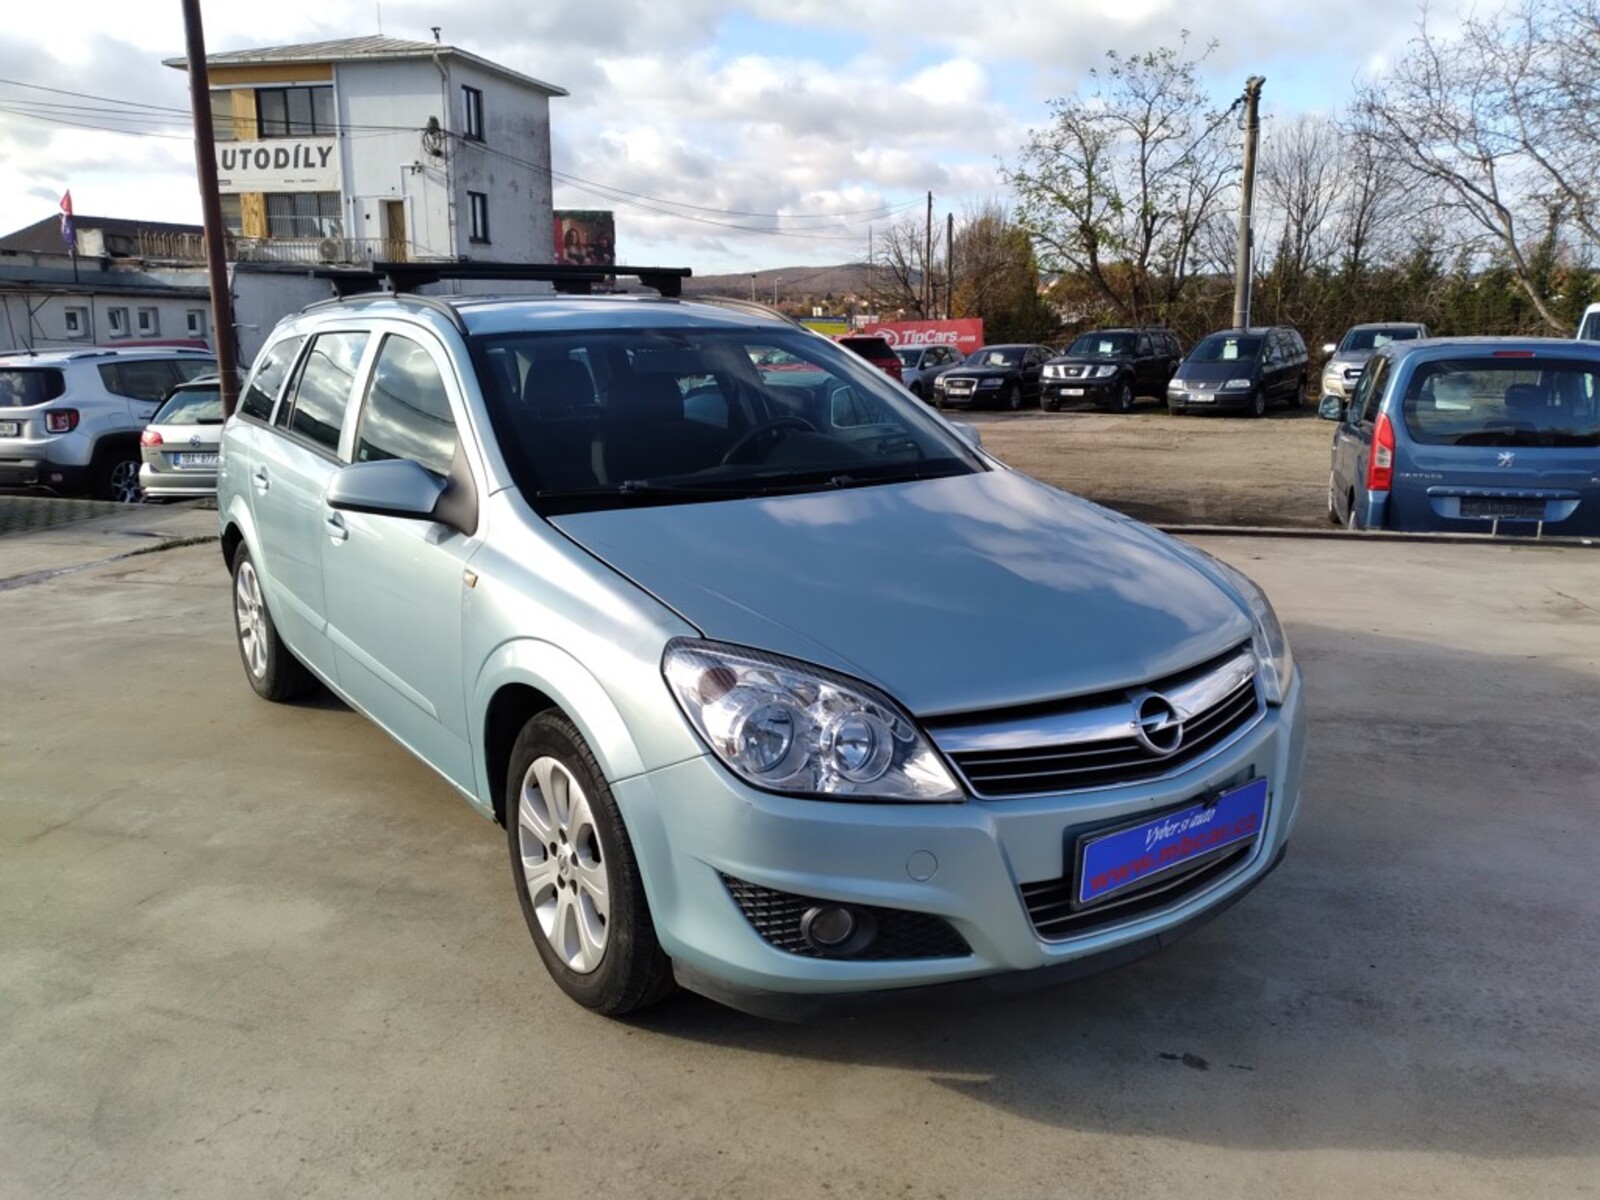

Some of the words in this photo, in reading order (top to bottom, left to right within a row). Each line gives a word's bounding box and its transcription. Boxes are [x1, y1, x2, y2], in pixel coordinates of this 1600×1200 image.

[220, 143, 333, 170] UTODÍLY
[901, 329, 976, 345] TipCars.com
[1091, 815, 1255, 890] www.mbcar.cz
